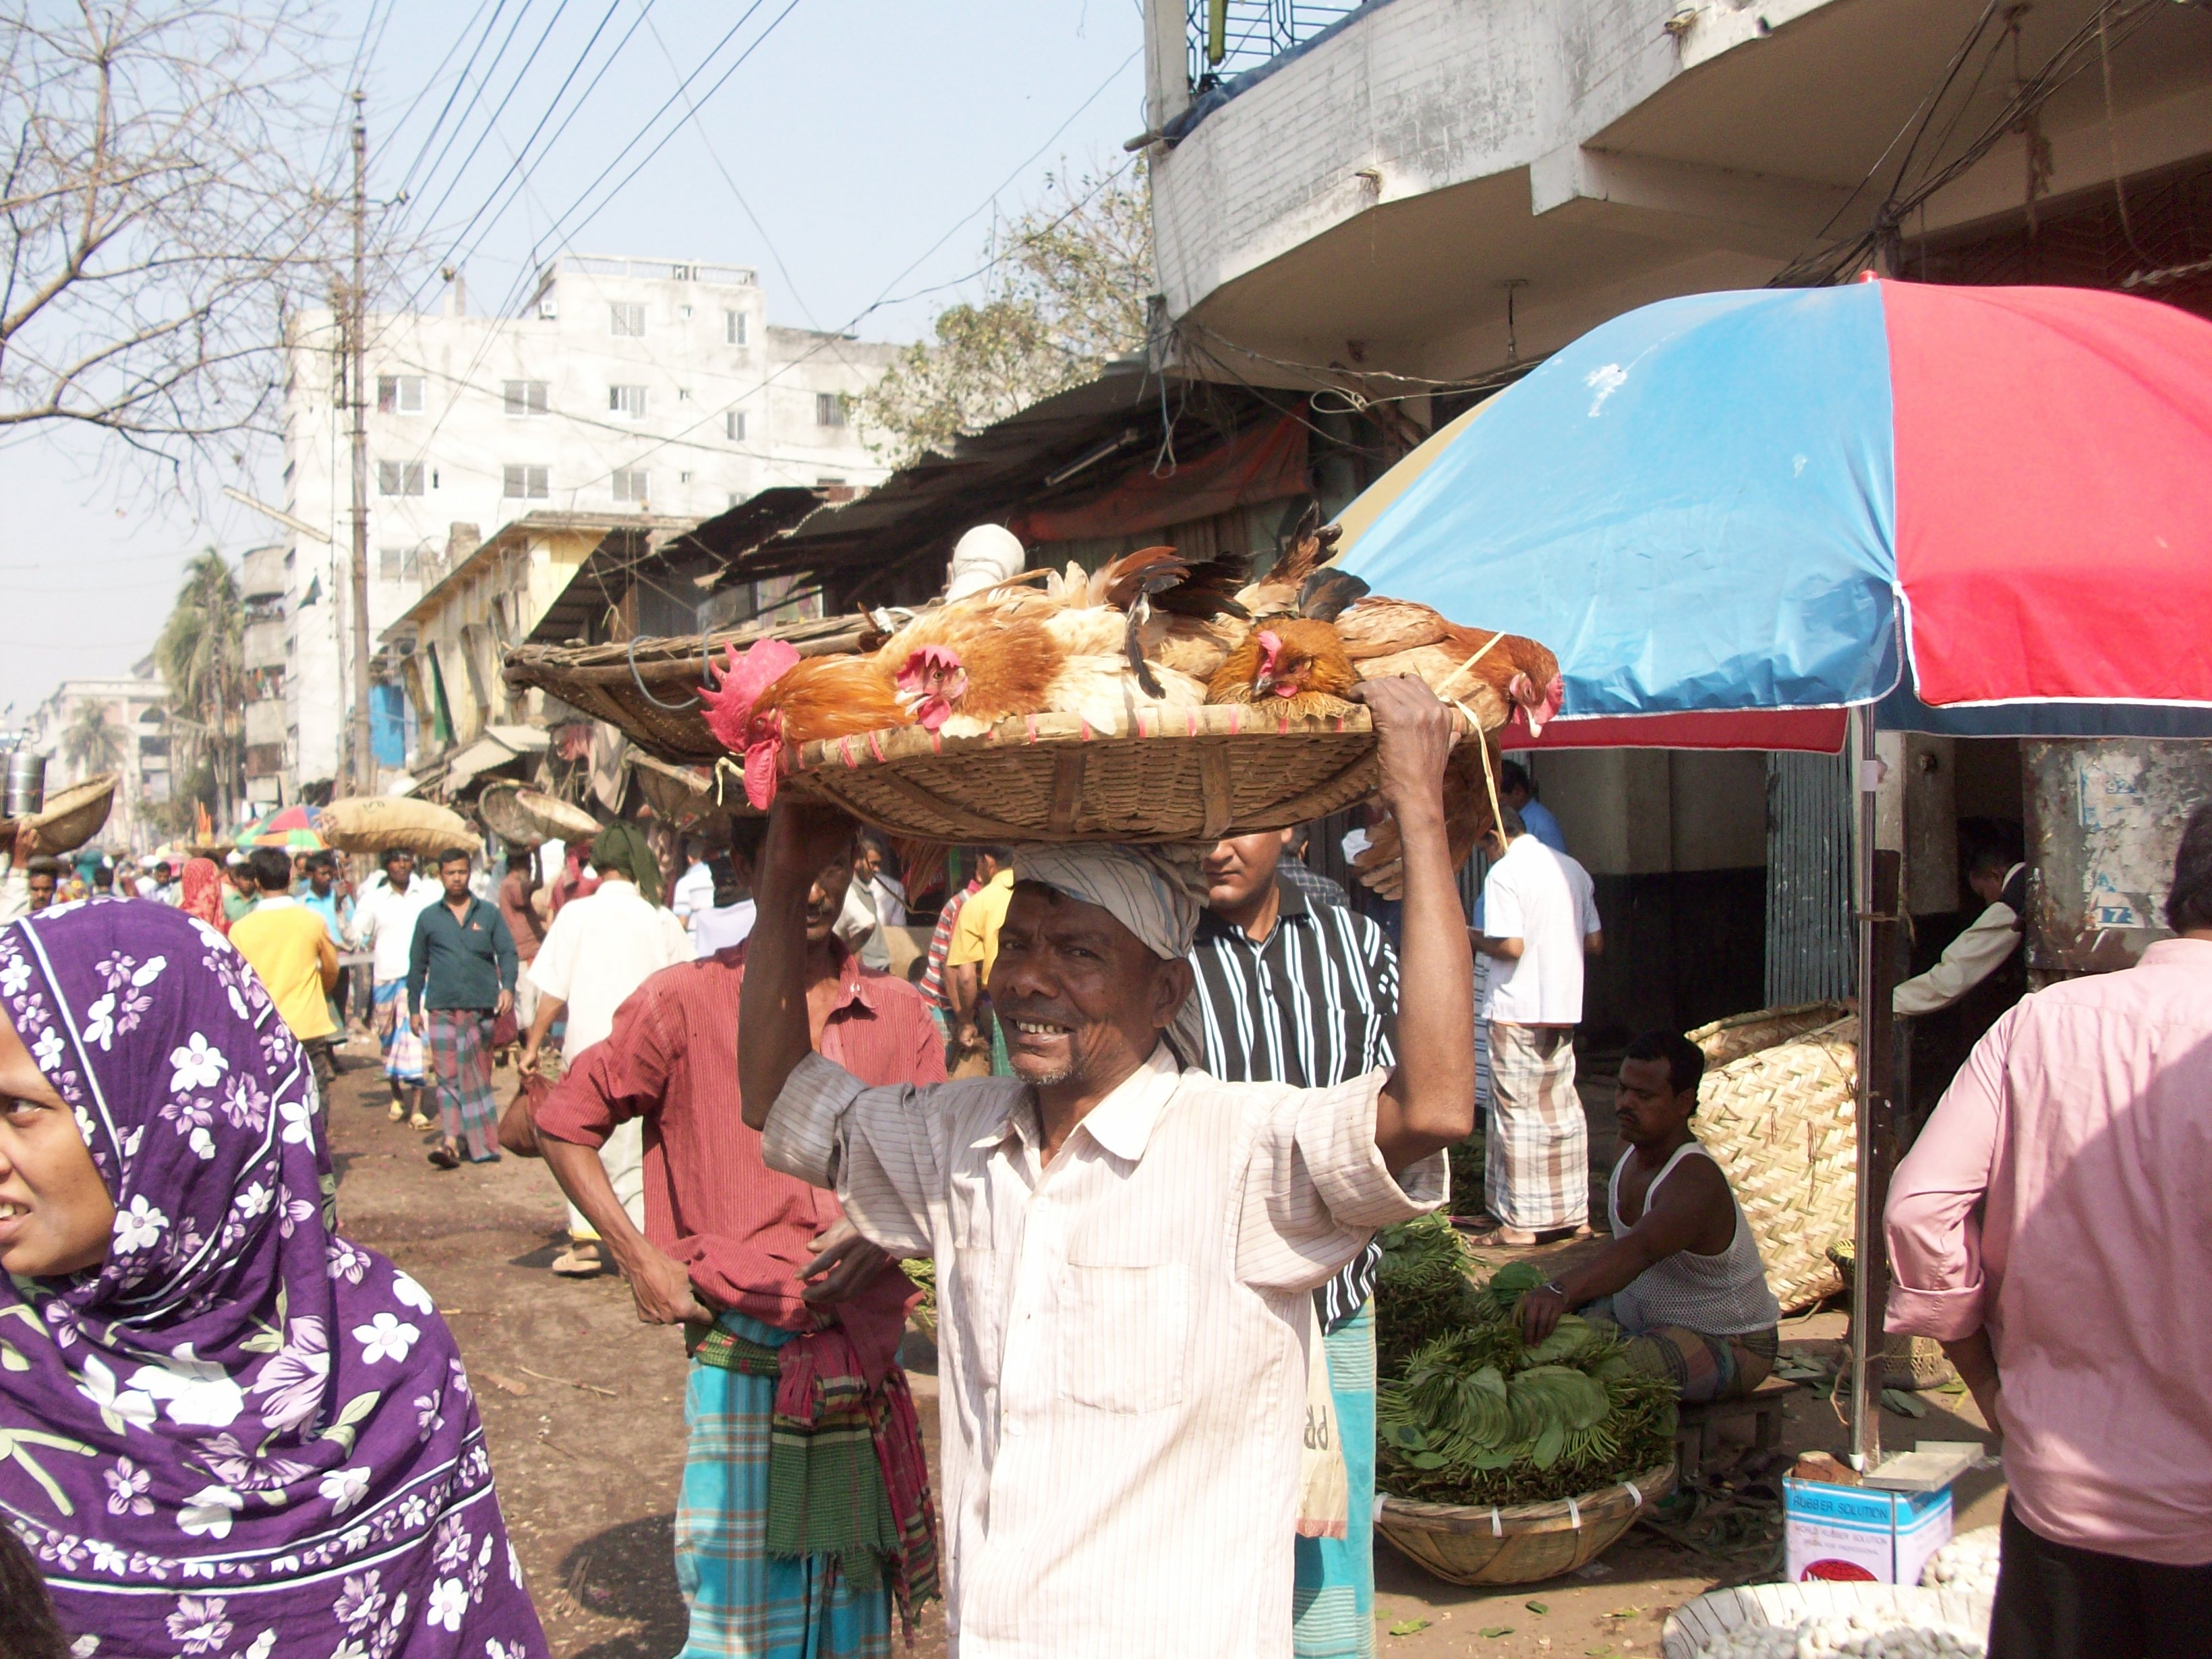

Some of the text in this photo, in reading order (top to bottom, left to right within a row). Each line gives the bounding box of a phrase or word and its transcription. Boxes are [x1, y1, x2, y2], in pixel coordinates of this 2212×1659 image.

[1793, 1495, 1888, 1519] RUBBER SOLUTION
[1794, 1524, 1888, 1544] WORLD RUBBER SOLUTION
